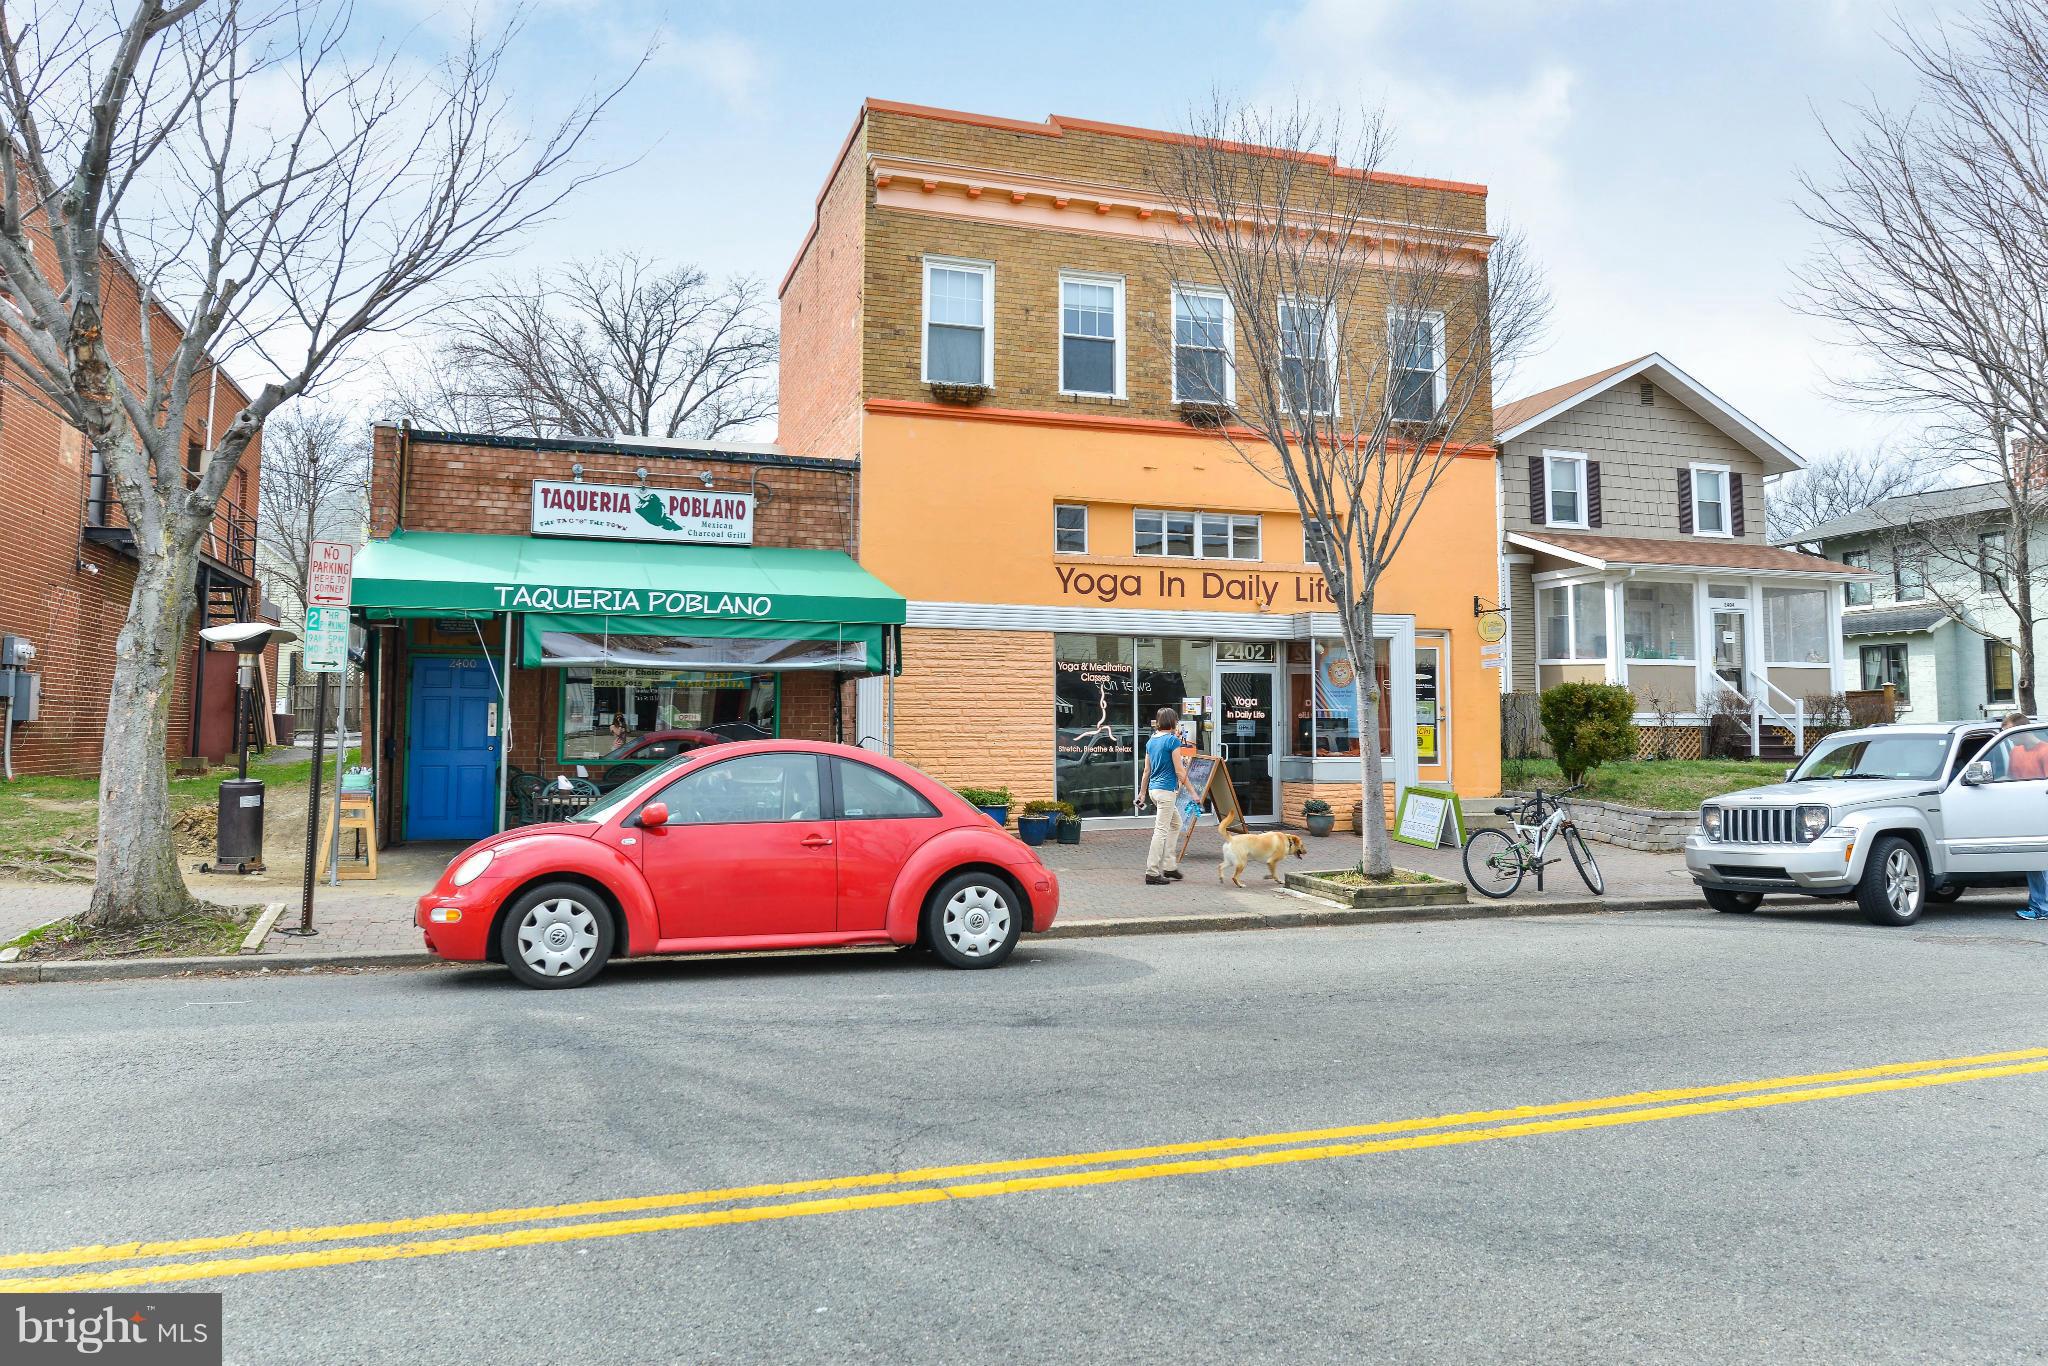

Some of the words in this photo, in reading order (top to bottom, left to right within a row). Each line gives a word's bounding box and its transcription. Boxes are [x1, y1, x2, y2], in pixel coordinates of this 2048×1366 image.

[541, 487, 631, 513] TAQUERIA
[669, 495, 746, 520] POBLANO
[701, 521, 733, 529] Mexican
[687, 529, 724, 538] Charcoal
[727, 531, 747, 539] Grill
[324, 547, 340, 560] NO
[312, 560, 349, 575] PARKING
[314, 574, 335, 584] HERE
[336, 575, 347, 584] TO
[314, 583, 345, 593] CORNER
[1055, 567, 1142, 603] Yoga
[1159, 570, 1185, 597] In
[1202, 572, 1279, 606] Daily
[494, 586, 640, 611] TAQUERIA
[648, 592, 772, 616] POBLANO
[308, 611, 319, 628] 2
[1224, 644, 1265, 660] 2402
[448, 659, 478, 669] 2400
[1058, 662, 1080, 671] Yoga
[1080, 662, 1089, 671] &
[1089, 661, 1132, 673] Meditation
[1081, 673, 1110, 682] Classes
[677, 680, 745, 688] MARGARITA
[1234, 697, 1258, 709] Yoga
[1227, 711, 1234, 719] In
[1235, 711, 1252, 720] Daily
[1253, 711, 1265, 719] Life
[1083, 745, 1108, 753] Breathe
[1115, 745, 1132, 753] Relax
